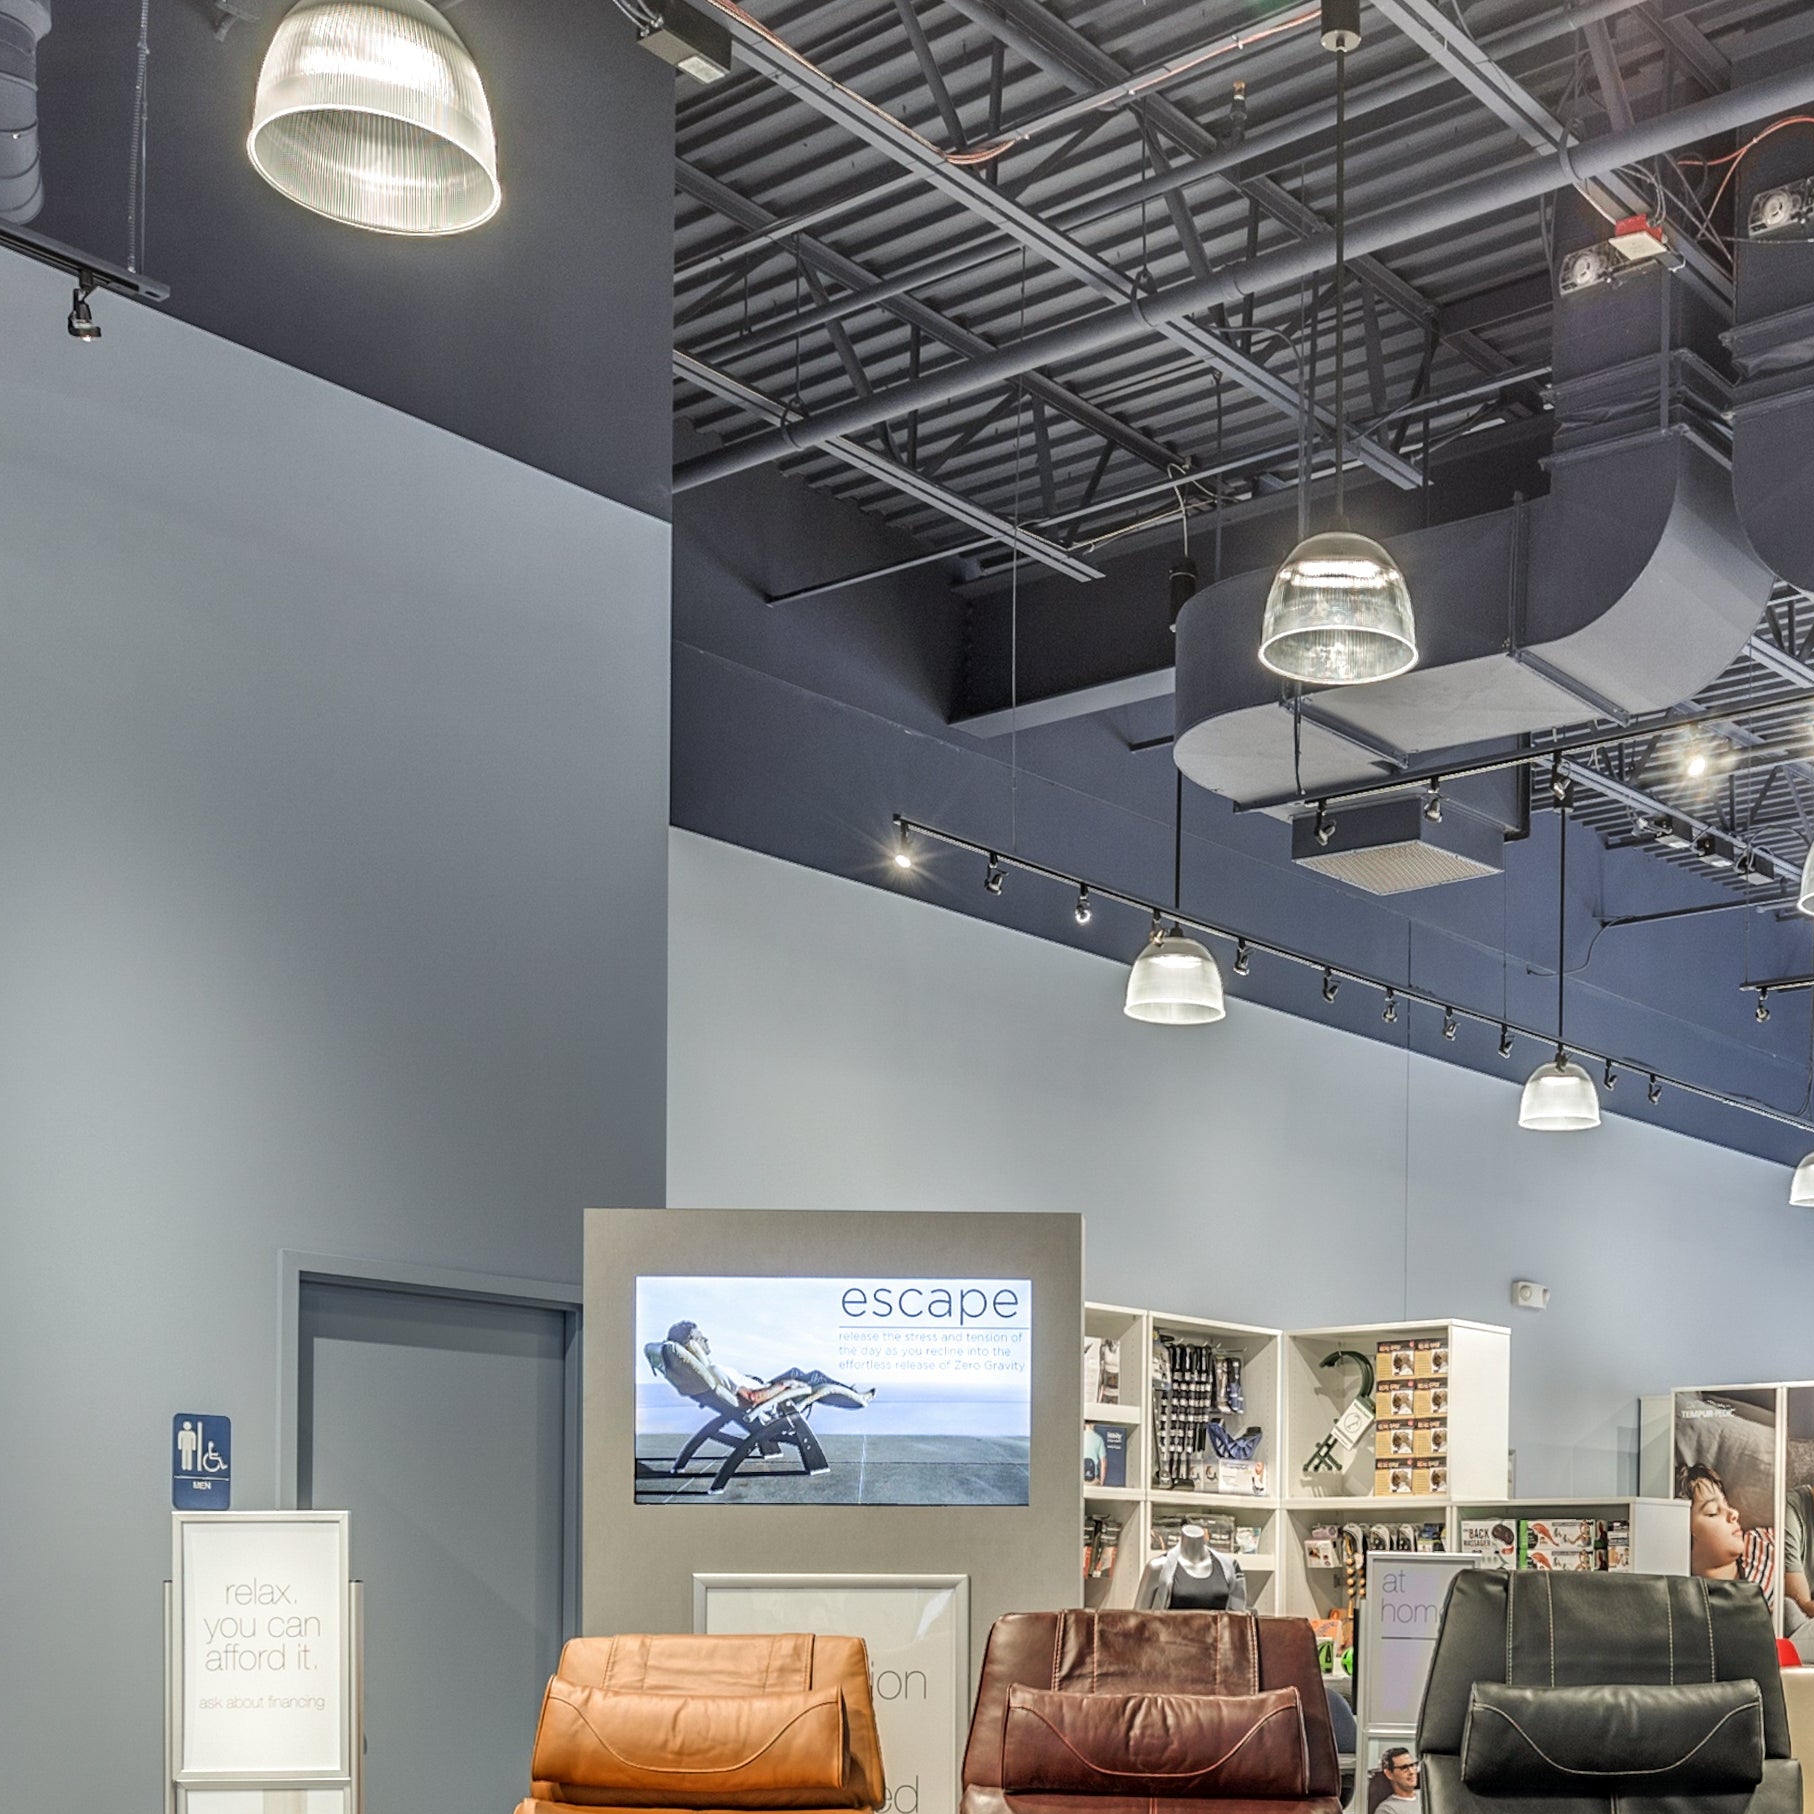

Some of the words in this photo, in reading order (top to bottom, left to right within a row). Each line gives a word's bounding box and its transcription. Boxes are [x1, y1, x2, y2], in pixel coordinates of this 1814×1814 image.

[841, 1287, 1019, 1327] escape
[838, 1332, 879, 1342] release
[882, 1332, 901, 1342] the
[904, 1332, 938, 1342] stress
[941, 1332, 963, 1343] and
[966, 1332, 1007, 1343] tension
[1011, 1333, 1023, 1343] of
[838, 1346, 857, 1356] the
[861, 1346, 881, 1358] day
[885, 1347, 898, 1356] as
[902, 1347, 922, 1358] you
[926, 1346, 964, 1357] recline
[967, 1346, 988, 1357] into
[993, 1347, 1011, 1357] the
[838, 1360, 892, 1370] effortless
[895, 1360, 935, 1370] release
[939, 1360, 952, 1370] of
[954, 1361, 981, 1371] Zero
[984, 1361, 1025, 1372] Gravity
[192, 1481, 212, 1491] MEN
[1469, 1528, 1489, 1539] BACK
[225, 1577, 297, 1605] relax.
[1381, 1569, 1407, 1593] at
[1380, 1597, 1445, 1624] hom
[203, 1616, 256, 1645] you
[267, 1615, 321, 1639] can
[204, 1643, 286, 1672] afford
[297, 1645, 318, 1671] it.
[199, 1696, 221, 1710] ask
[225, 1696, 265, 1710] about
[267, 1695, 326, 1712] financing
